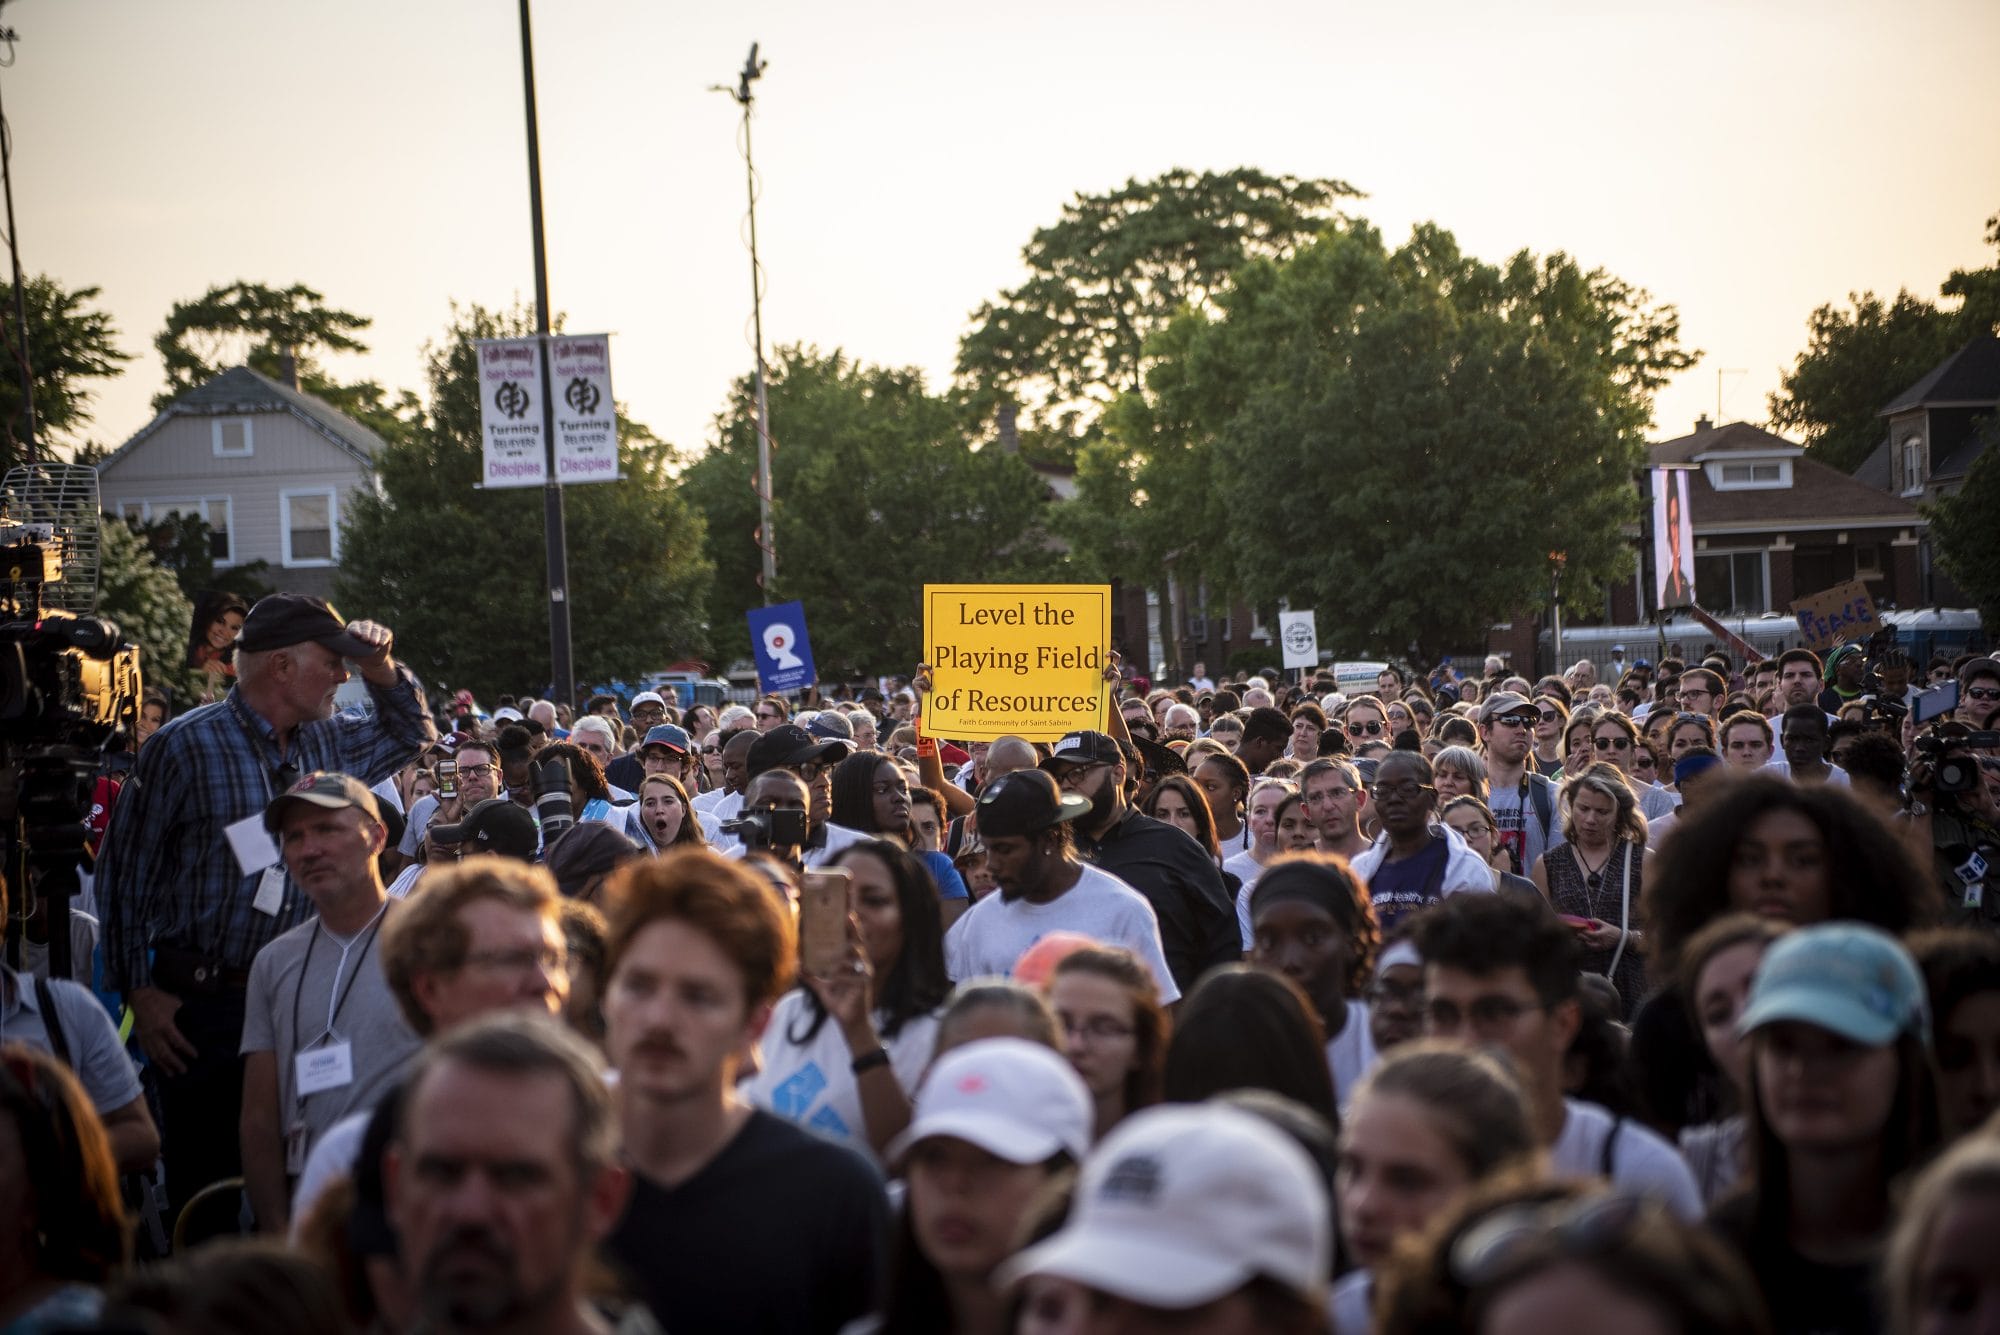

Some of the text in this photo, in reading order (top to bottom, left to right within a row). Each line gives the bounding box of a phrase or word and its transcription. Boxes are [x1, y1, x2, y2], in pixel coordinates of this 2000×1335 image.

[489, 423, 540, 435] Turning
[559, 420, 610, 431] Turning
[489, 461, 541, 479] Disciples
[560, 457, 611, 474] Disciples
[959, 602, 1075, 625] Level the
[1798, 598, 1872, 643] PEACE
[935, 645, 1100, 675] Playing Field
[934, 688, 1098, 712] of Resources
[959, 718, 976, 726] Faith
[978, 719, 1019, 727] Community
